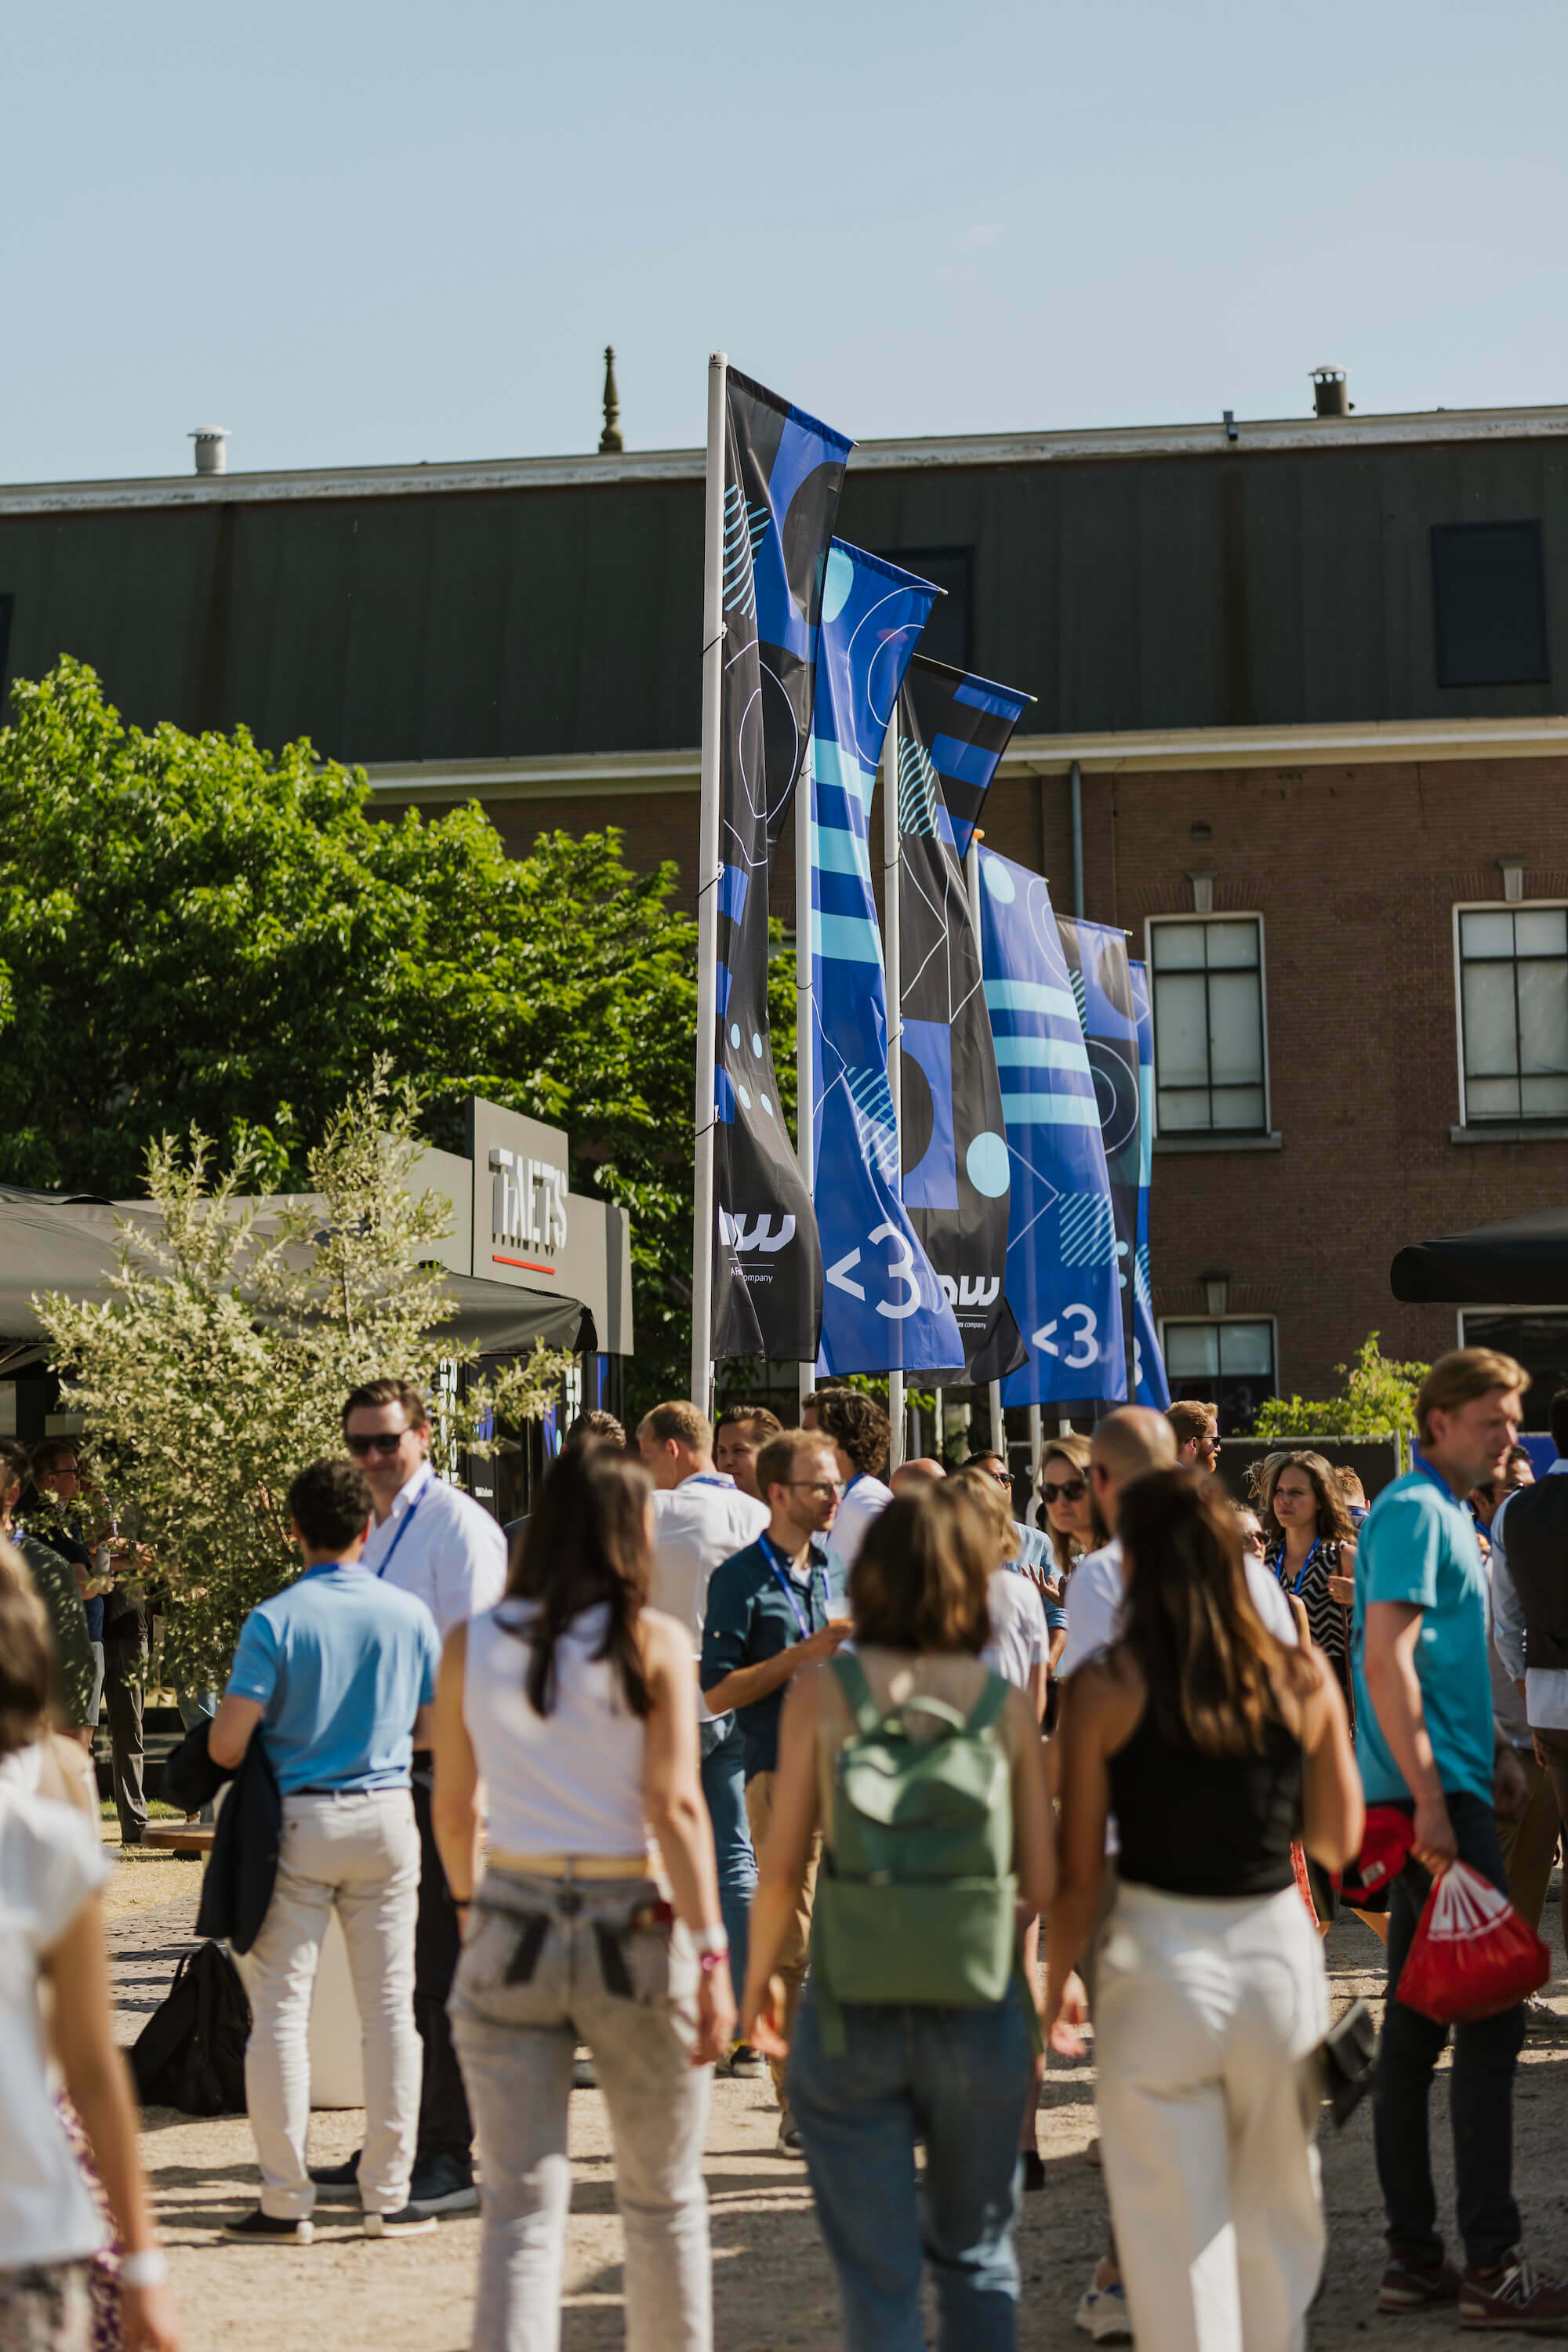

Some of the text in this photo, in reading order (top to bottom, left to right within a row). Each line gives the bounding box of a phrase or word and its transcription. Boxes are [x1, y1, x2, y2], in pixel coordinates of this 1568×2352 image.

[491, 1148, 568, 1248] TAETS
[743, 1274, 773, 1283] ompany
[826, 1222, 921, 1319] <3
[1031, 1303, 1098, 1369] <3
